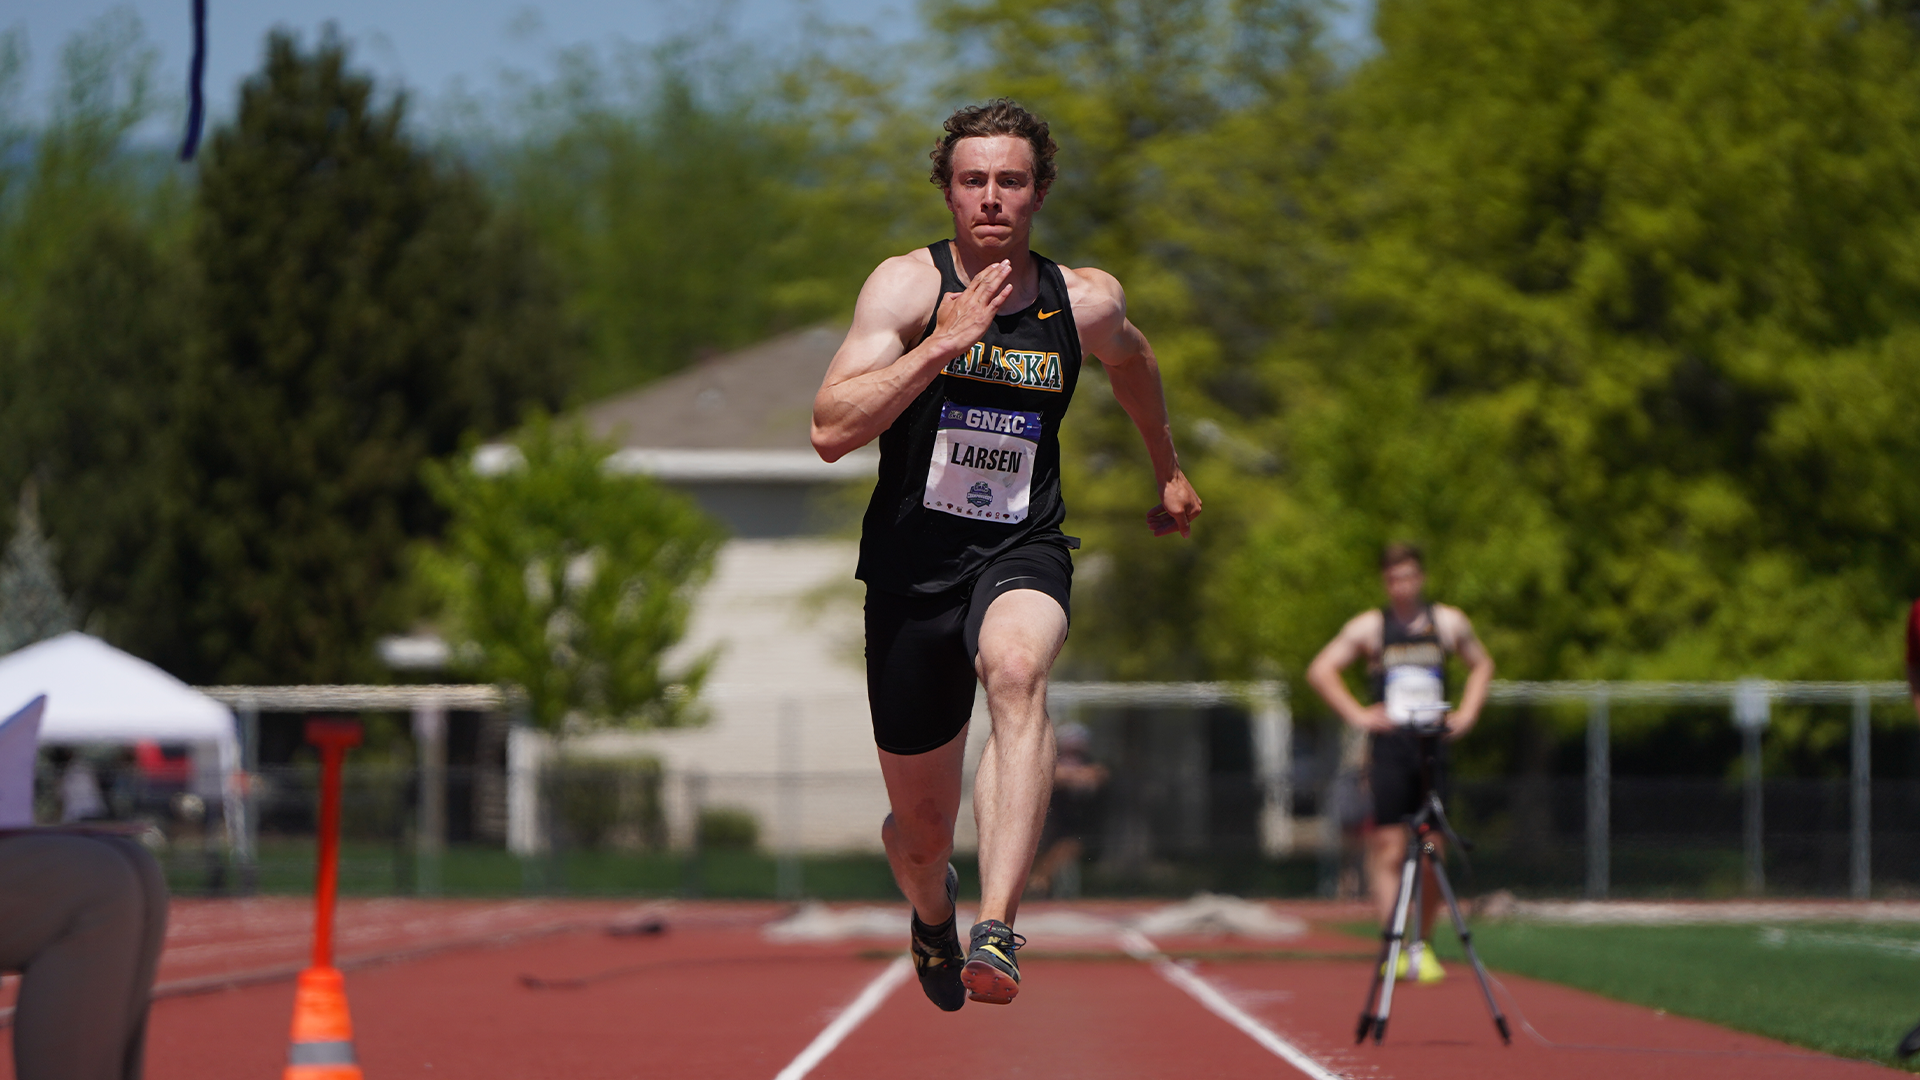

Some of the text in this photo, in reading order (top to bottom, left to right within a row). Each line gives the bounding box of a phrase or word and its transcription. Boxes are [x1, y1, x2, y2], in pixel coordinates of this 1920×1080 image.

[941, 341, 1064, 393] ALASKA
[965, 408, 1026, 435] GNAC
[950, 442, 1023, 474] LARSEN
